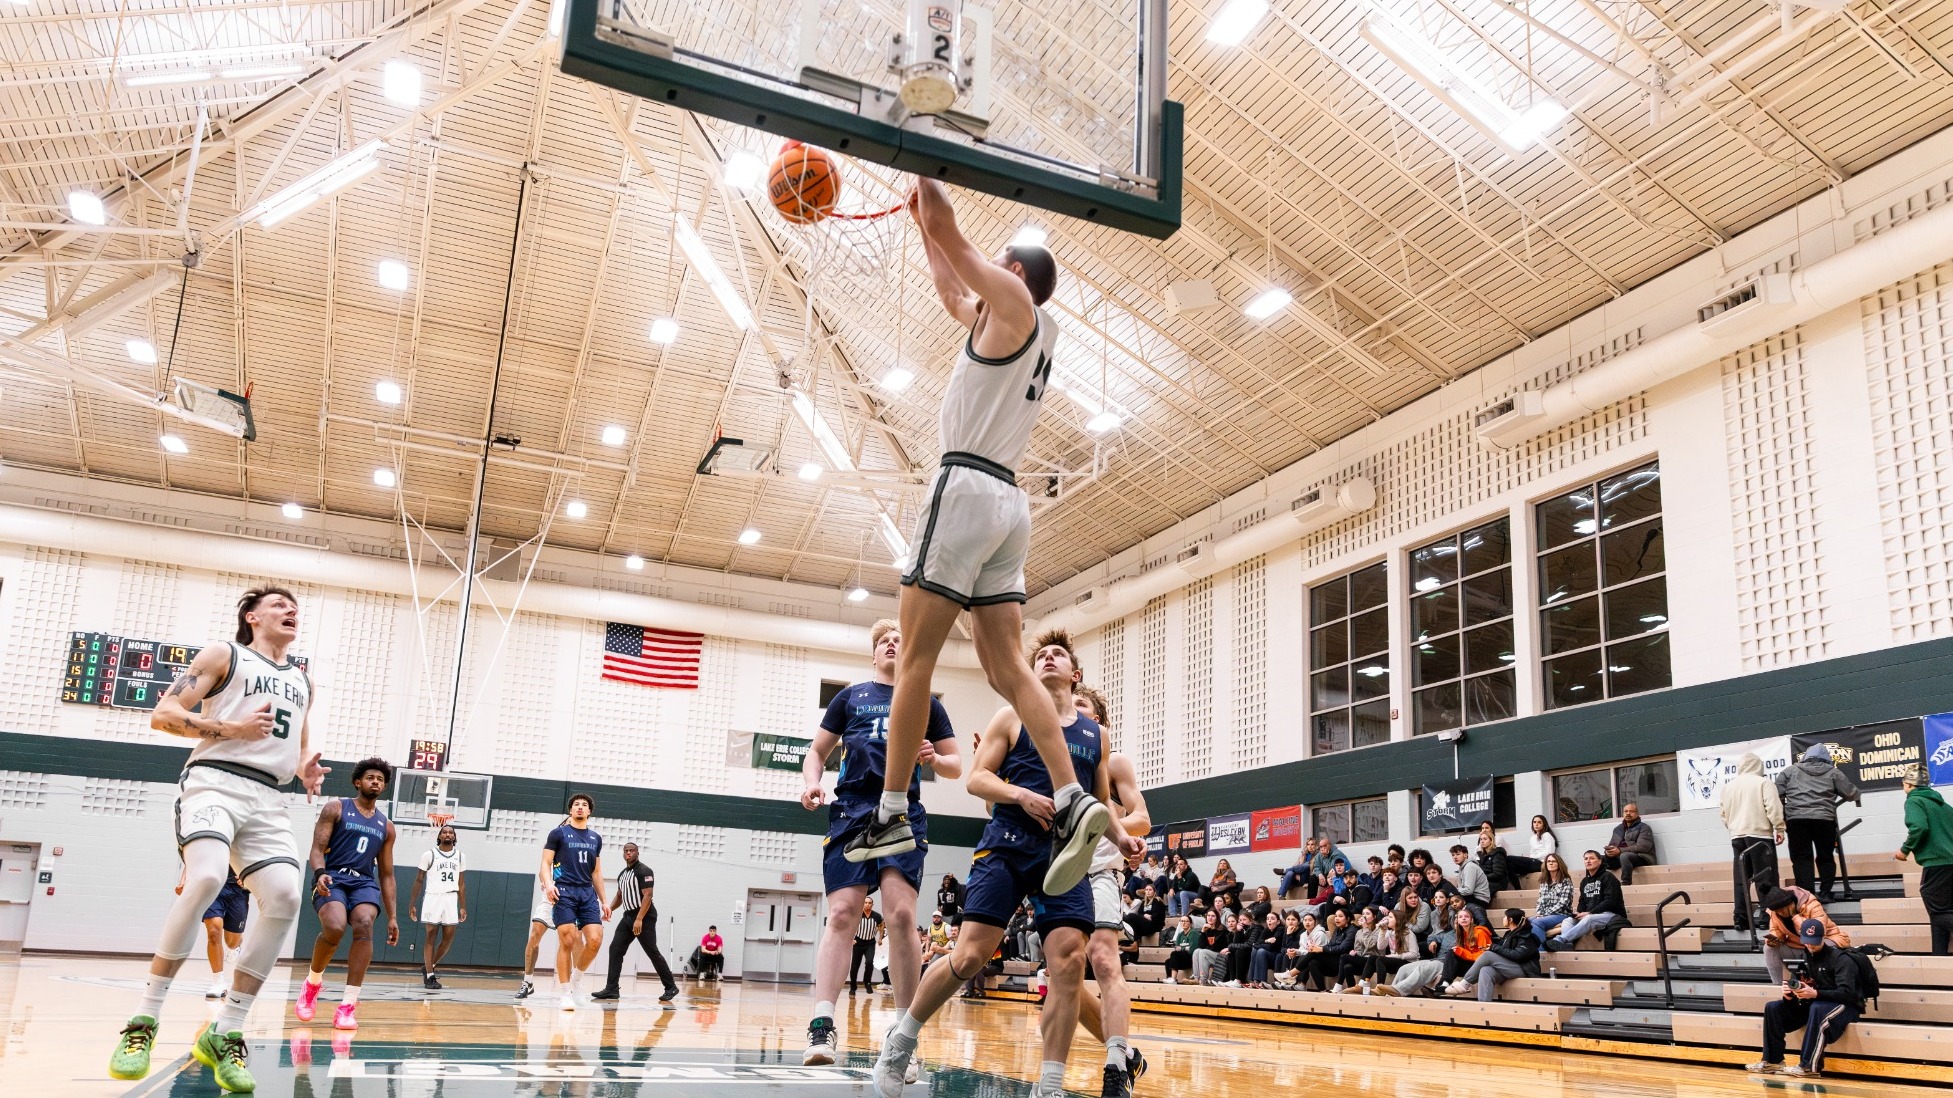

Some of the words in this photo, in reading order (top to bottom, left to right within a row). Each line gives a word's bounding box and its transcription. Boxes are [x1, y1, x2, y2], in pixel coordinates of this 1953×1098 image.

[935, 34, 949, 62] 2
[771, 168, 816, 198] Wilson
[79, 641, 85, 649] 5
[92, 642, 99, 651] 0
[112, 644, 118, 653] 0
[128, 641, 153, 651] HOME
[89, 655, 97, 664] 0
[110, 656, 116, 665] 0
[140, 653, 153, 669] 0
[87, 667, 95, 676] 0
[107, 669, 114, 678] 0
[132, 671, 154, 679] BONUS
[85, 680, 93, 689] 0
[105, 682, 112, 691] 0
[244, 675, 280, 697] LAKE
[83, 693, 91, 702] 0
[103, 695, 110, 704] 0
[135, 688, 146, 702] 0
[1874, 733, 1901, 747] OHIO
[415, 740, 444, 754] 19:58
[760, 742, 775, 752] LAKE
[775, 744, 788, 754] ERIE
[789, 746, 810, 756] COLLEG
[414, 753, 438, 770] 29
[772, 753, 800, 764] STORM
[1859, 747, 1919, 765] DOMINICAN
[1724, 758, 1786, 775] NOOOD
[1859, 762, 1918, 782] UNIVERS
[1457, 793, 1475, 803] LAKE
[1475, 790, 1491, 801] ERIE
[1427, 807, 1456, 820] STORM
[1460, 802, 1489, 813] COLLEGE
[356, 836, 369, 854] 0
[578, 850, 588, 863] 11
[441, 871, 454, 882] 34
